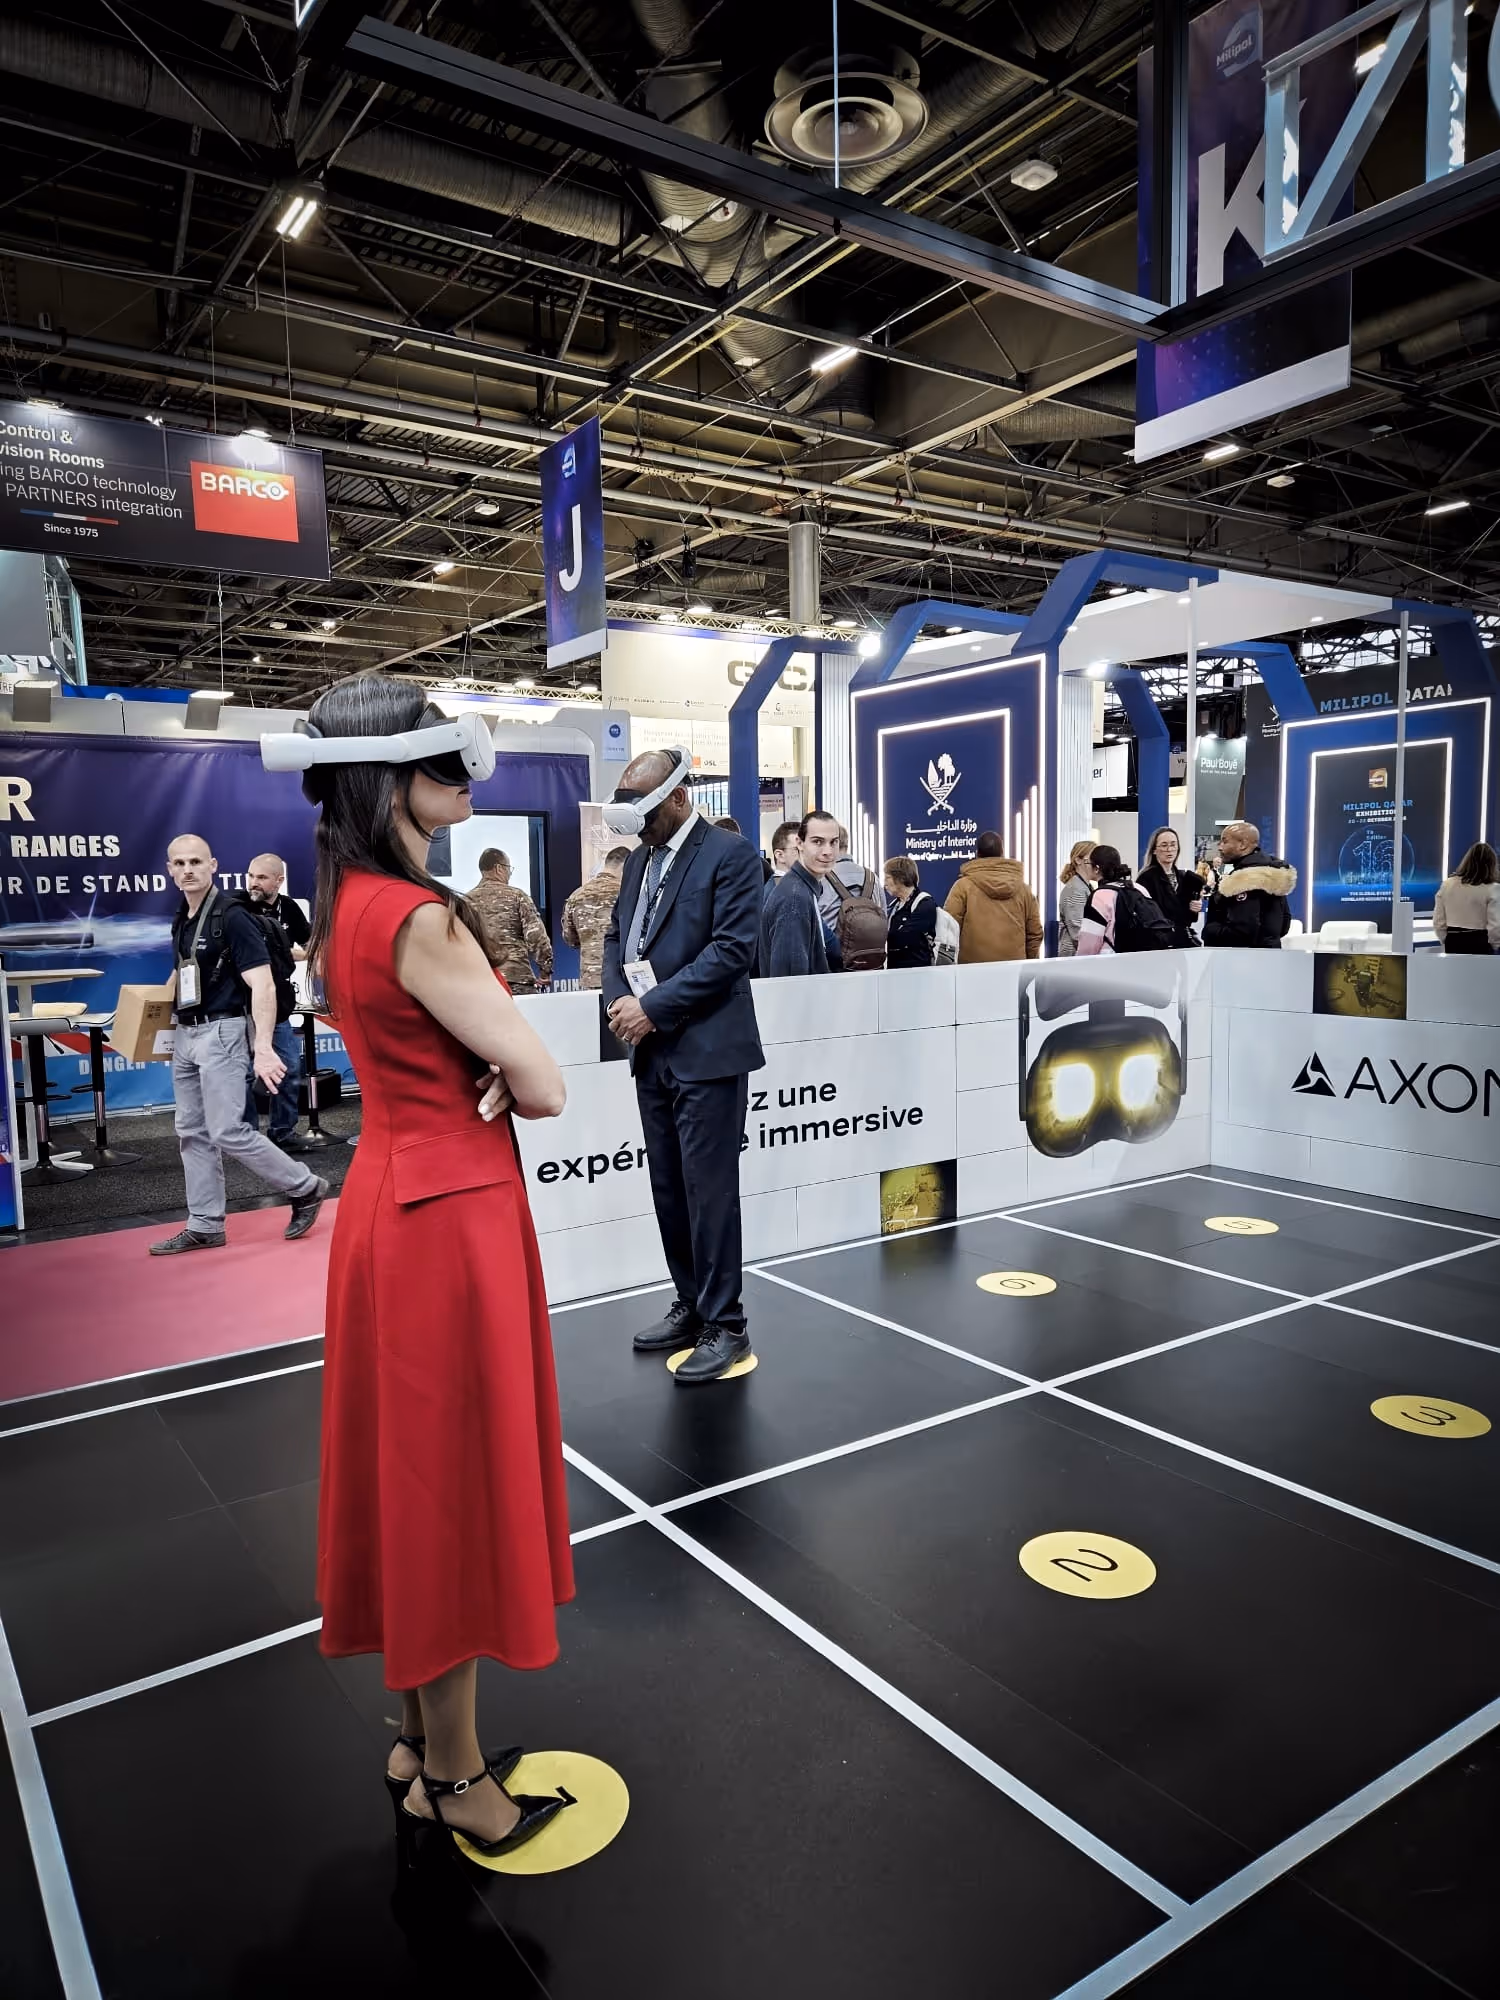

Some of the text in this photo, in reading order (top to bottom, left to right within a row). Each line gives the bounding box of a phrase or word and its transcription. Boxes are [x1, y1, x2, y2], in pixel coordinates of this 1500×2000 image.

[1216, 34, 1253, 67] Milipol
[0, 420, 73, 445] Control &
[49, 447, 105, 469] Rooms
[29, 464, 89, 487] BARCO
[93, 474, 177, 501] technology
[200, 471, 289, 501] BARCO
[6, 483, 183, 519] PARTNERS integration
[44, 523, 99, 537] Since 1975
[559, 503, 583, 592] J
[1320, 692, 1394, 713] MILIPOL
[1200, 757, 1218, 768] Paul
[1218, 758, 1238, 771] Boyé
[0, 776, 36, 822] R
[1343, 800, 1413, 811] MILIPOL QAAR
[960, 818, 977, 833] وزارة
[11, 835, 121, 858] RANGES
[905, 835, 977, 851] Ministry of Interior
[37, 875, 70, 894] DE
[83, 874, 167, 893] STAND
[218, 873, 250, 891] TI
[777, 1082, 838, 1108] une
[759, 1106, 924, 1149] immersive
[1400, 1405, 1457, 1426] 3
[1049, 1548, 1119, 1582] 2
